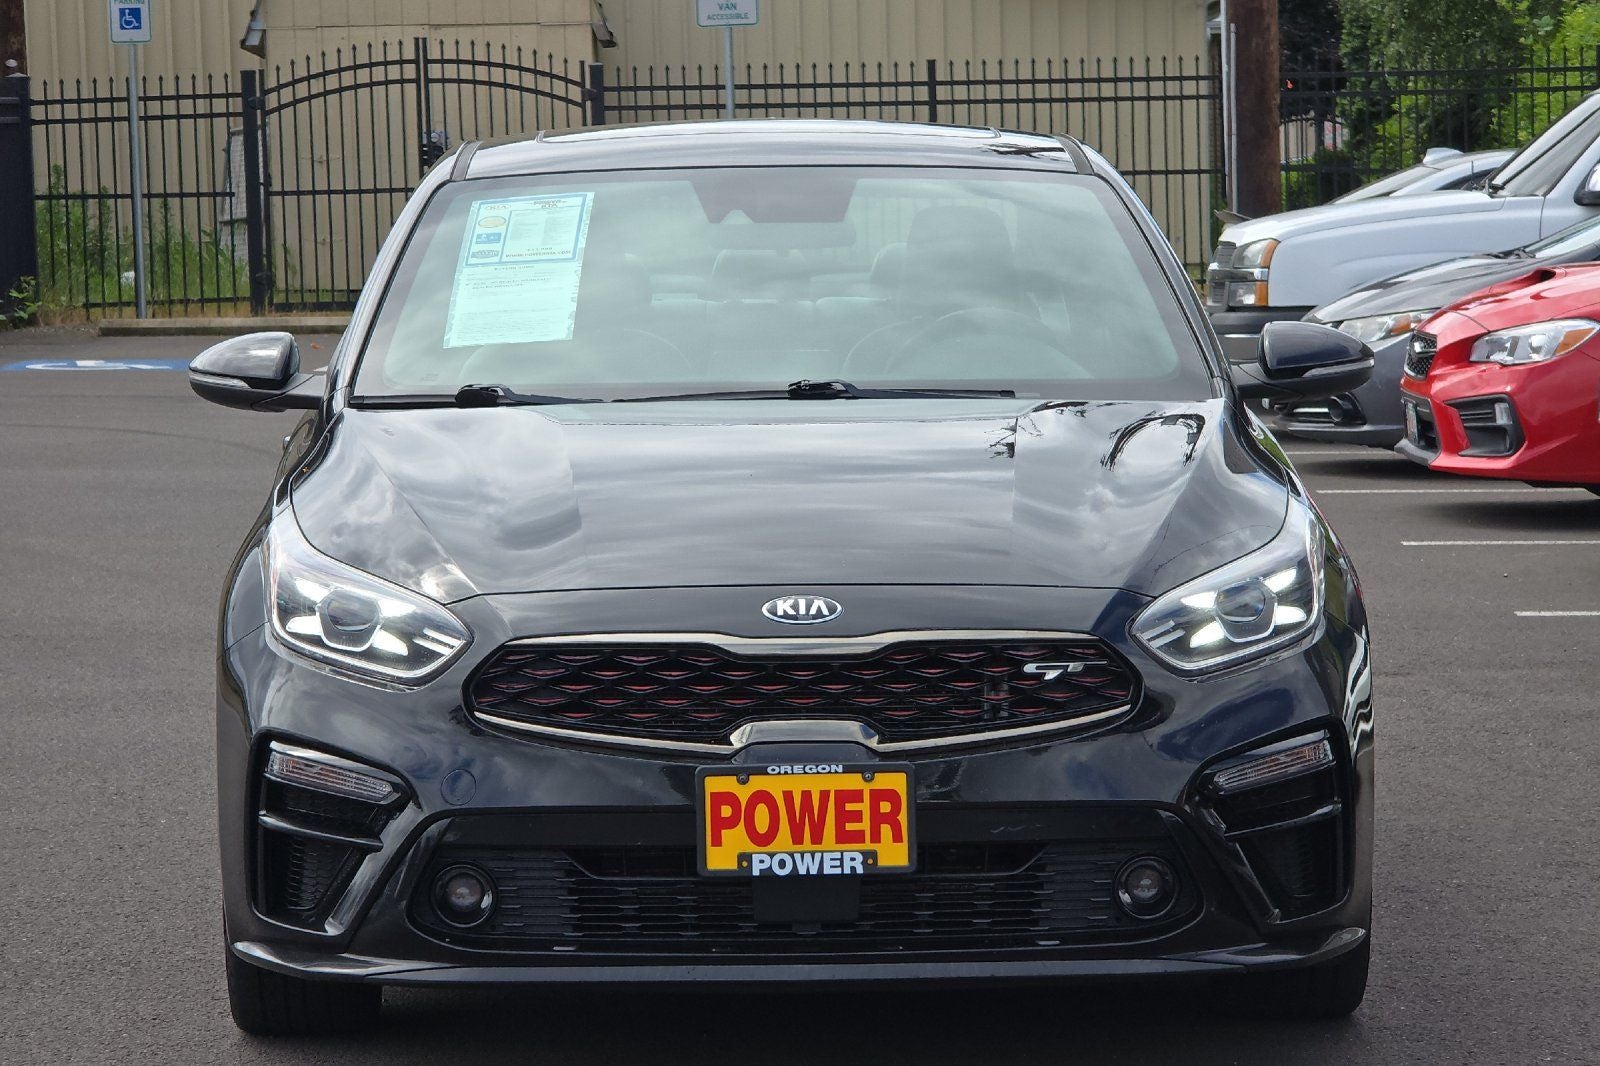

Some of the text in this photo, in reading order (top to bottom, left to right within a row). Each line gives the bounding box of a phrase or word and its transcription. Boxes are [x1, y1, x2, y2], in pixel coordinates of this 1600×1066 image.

[717, 2, 738, 11] VAN
[707, 12, 750, 20] ACCESSIBLE
[775, 598, 830, 616] KIA
[1023, 660, 1108, 680] GT
[766, 764, 844, 775] OREGON
[709, 788, 905, 848] POWER
[751, 851, 865, 876] POWER
